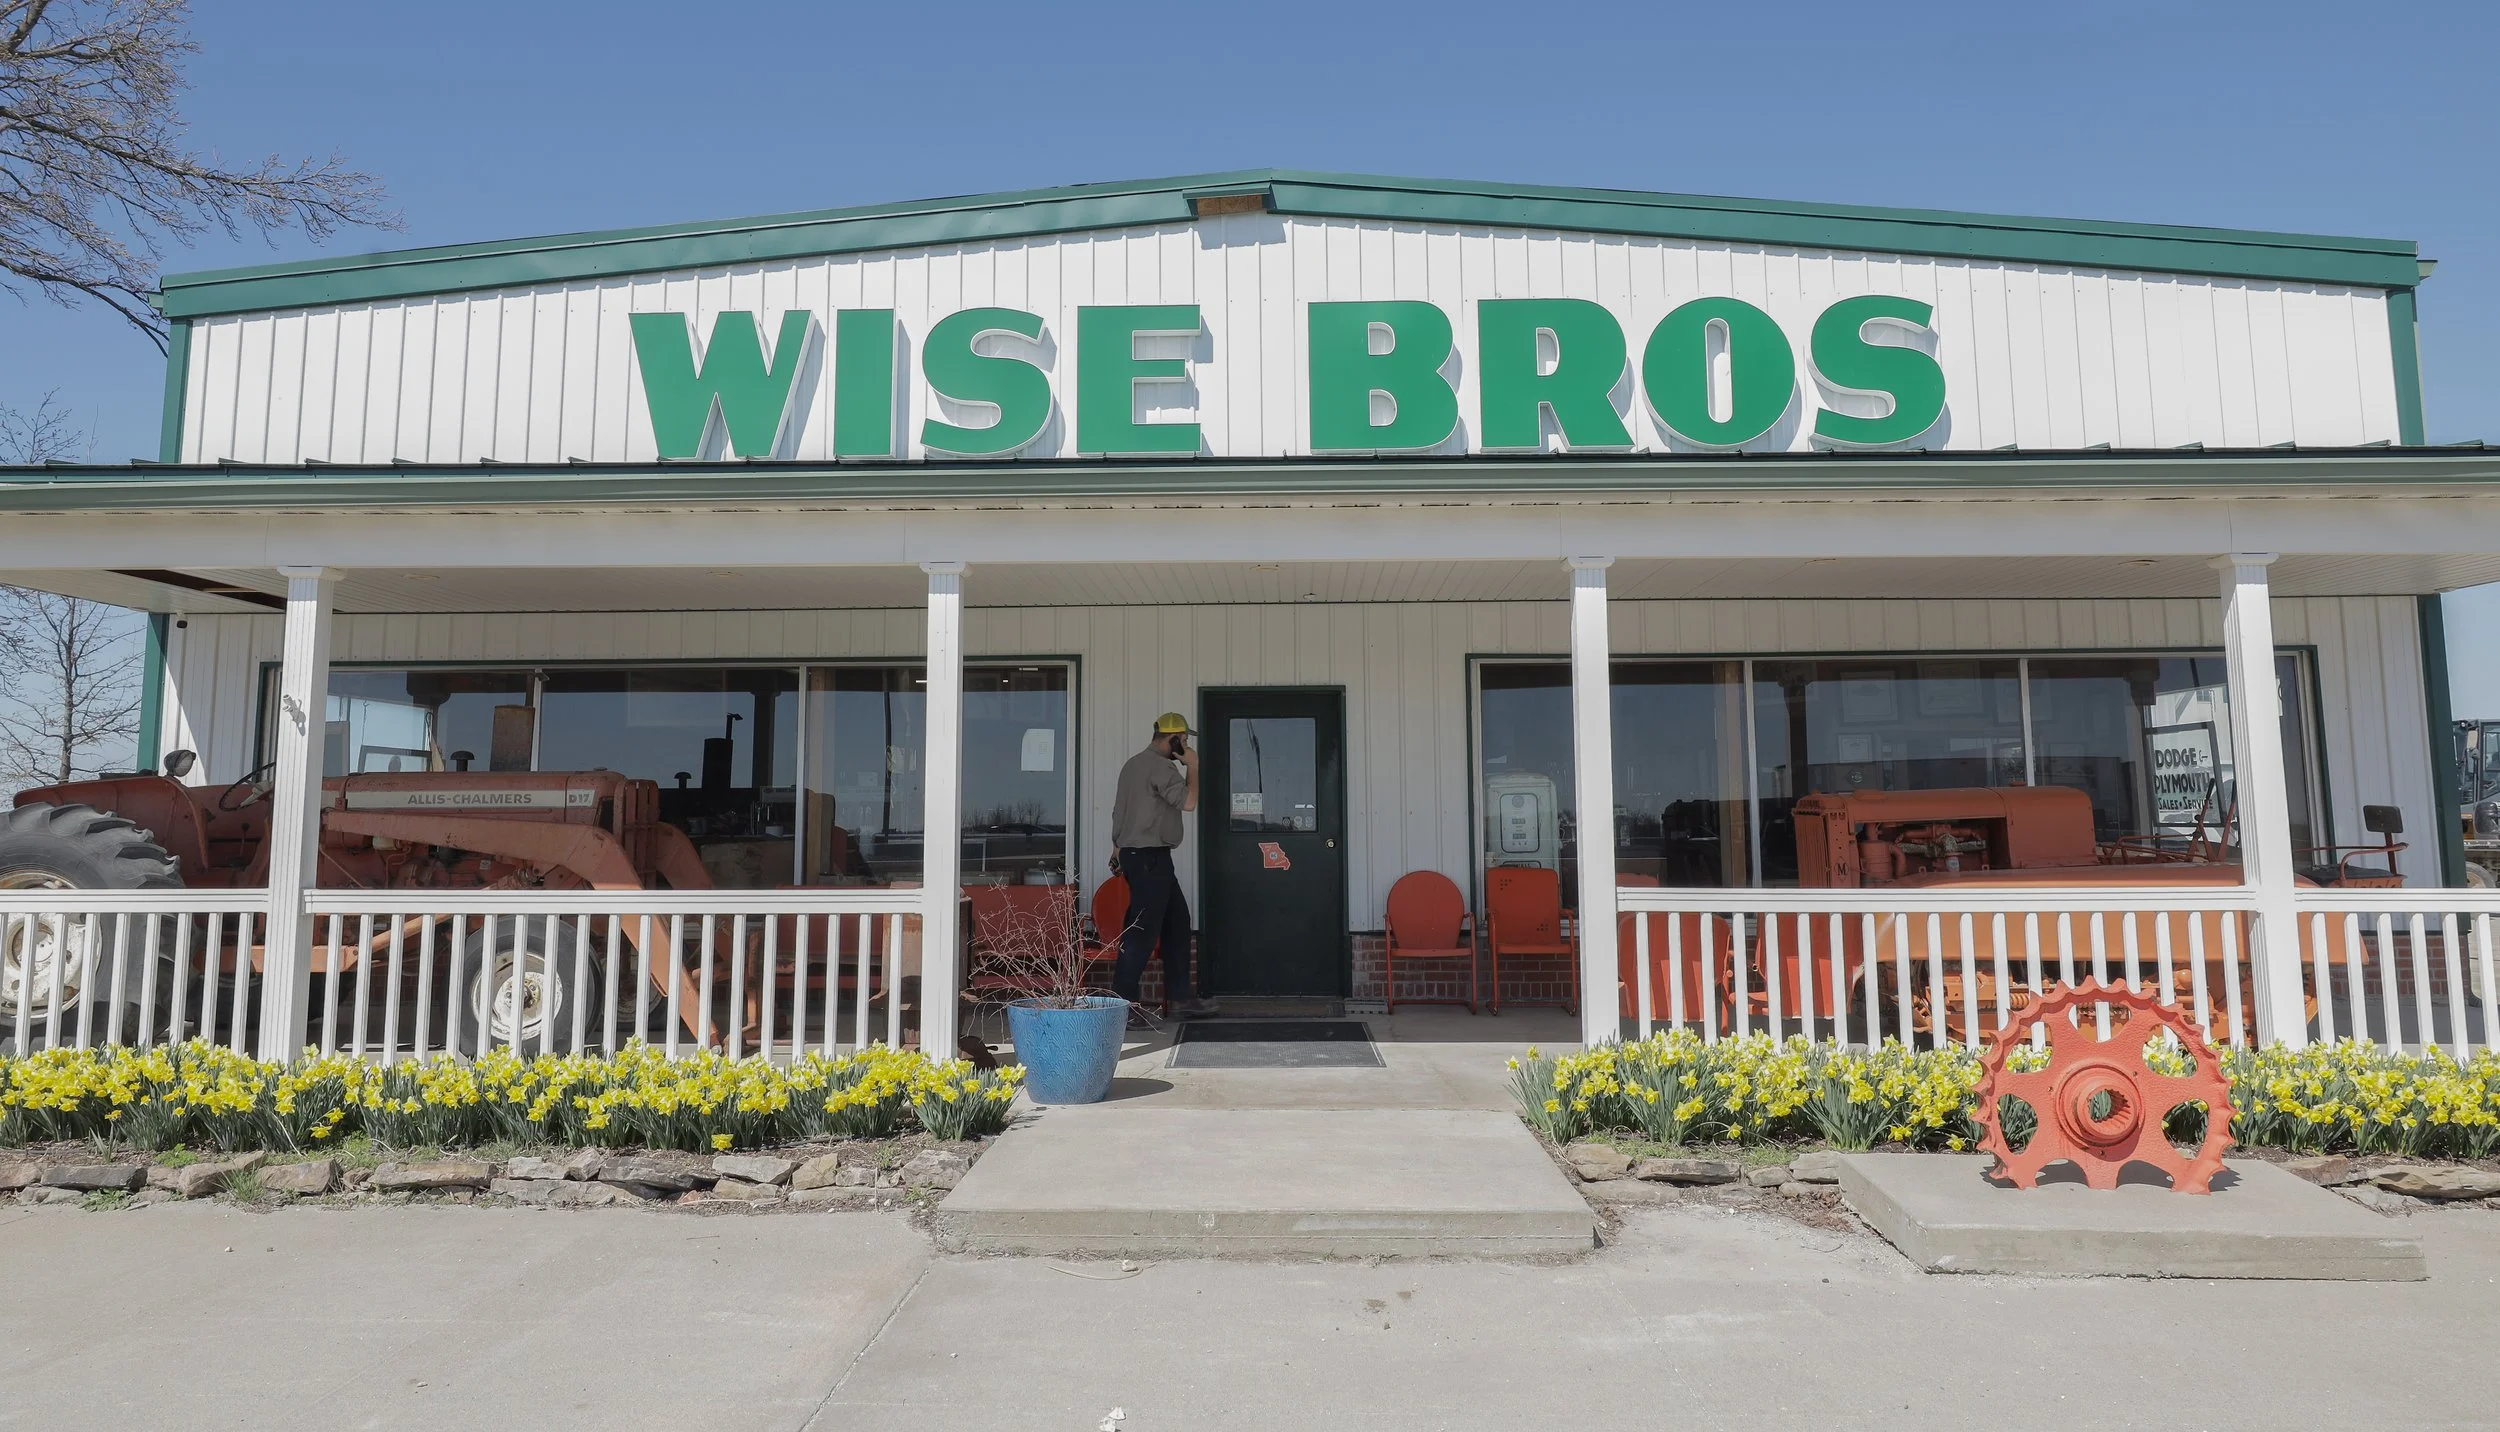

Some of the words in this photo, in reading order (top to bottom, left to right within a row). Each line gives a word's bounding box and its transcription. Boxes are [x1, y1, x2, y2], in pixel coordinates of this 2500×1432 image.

[628, 304, 1203, 460] WISE
[1308, 295, 1947, 455] BROS
[2155, 747, 2198, 769] DODGE
[2153, 772, 2211, 794] PLYMOUTH
[407, 793, 532, 805] ALLIS-CHALMERS
[2158, 797, 2179, 810] SALES
[1837, 862, 1847, 876] M
